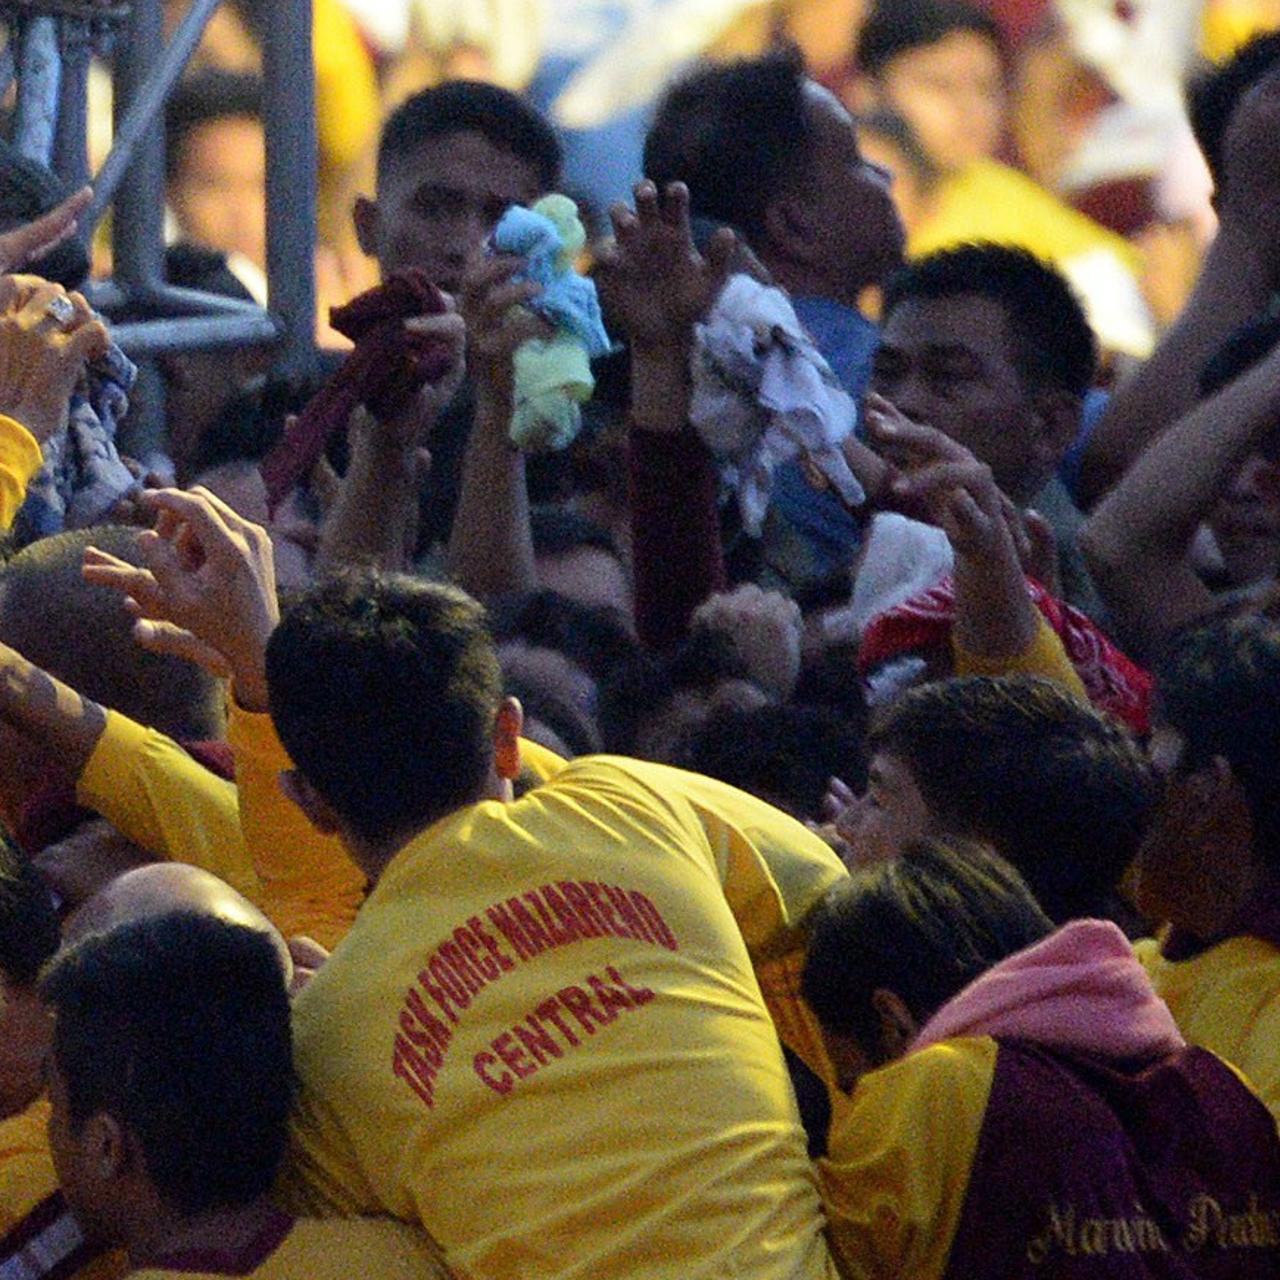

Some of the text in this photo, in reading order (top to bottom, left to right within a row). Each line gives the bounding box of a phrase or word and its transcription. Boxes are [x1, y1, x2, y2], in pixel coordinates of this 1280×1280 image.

[392, 880, 679, 1110] TASK FORCE NAZARENO
[473, 965, 656, 1096] CENTRAL
